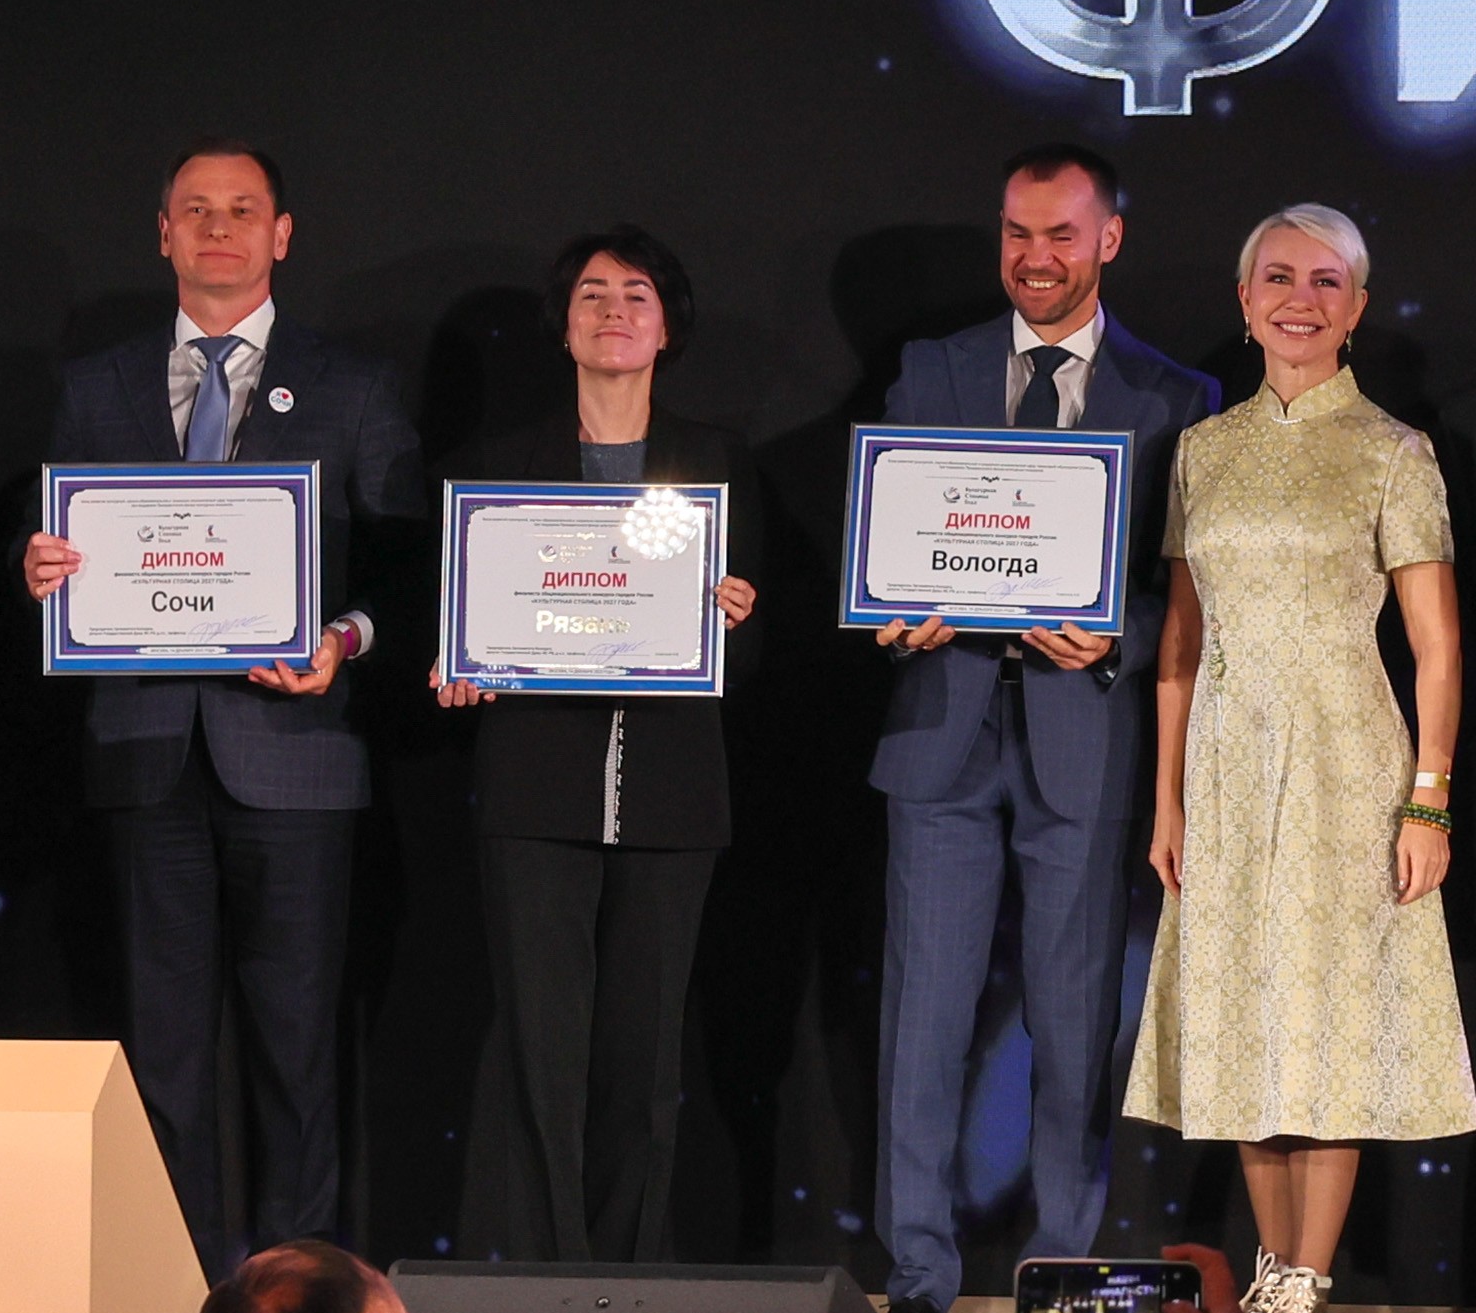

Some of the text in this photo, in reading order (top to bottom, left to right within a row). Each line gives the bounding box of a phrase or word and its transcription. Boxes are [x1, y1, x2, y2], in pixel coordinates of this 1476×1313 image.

[945, 513, 1030, 530] ДИПЛОМ
[141, 552, 224, 570] ДИПЛОМ
[932, 550, 1038, 577] Вологда
[542, 572, 627, 589] ДИПЛОМ
[151, 591, 213, 612] Сочи
